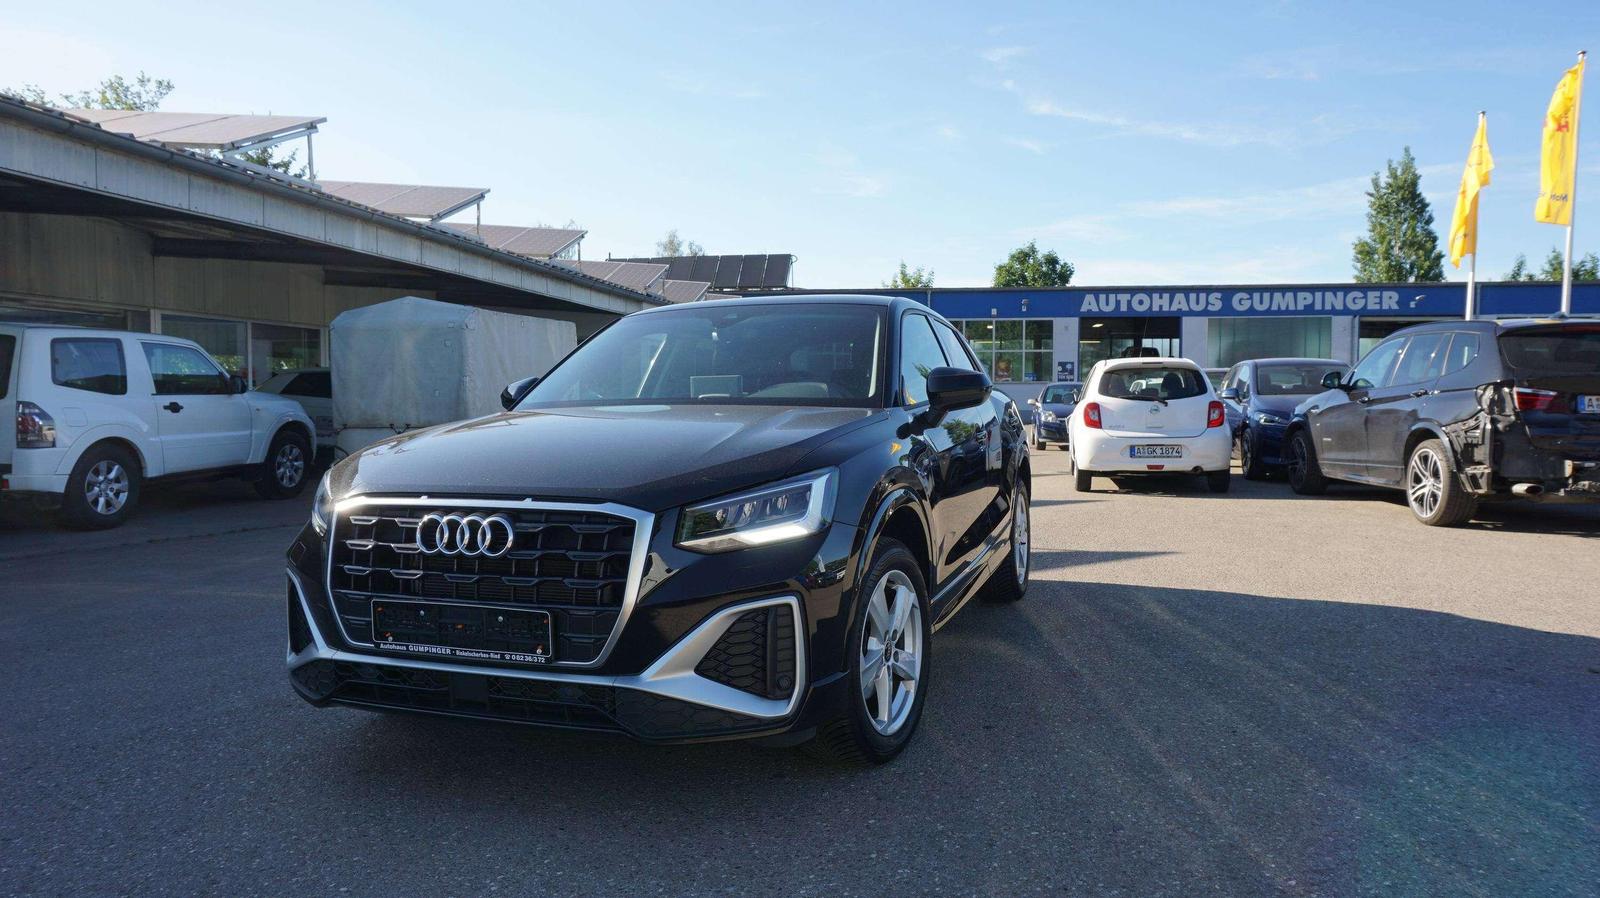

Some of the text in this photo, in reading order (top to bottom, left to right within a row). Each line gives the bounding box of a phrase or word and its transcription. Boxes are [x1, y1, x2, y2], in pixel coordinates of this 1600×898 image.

[1080, 291, 1400, 312] AUTOHAUS GUMPINGER
[380, 643, 407, 651] Autohaus
[408, 644, 452, 655] GUMPINGER
